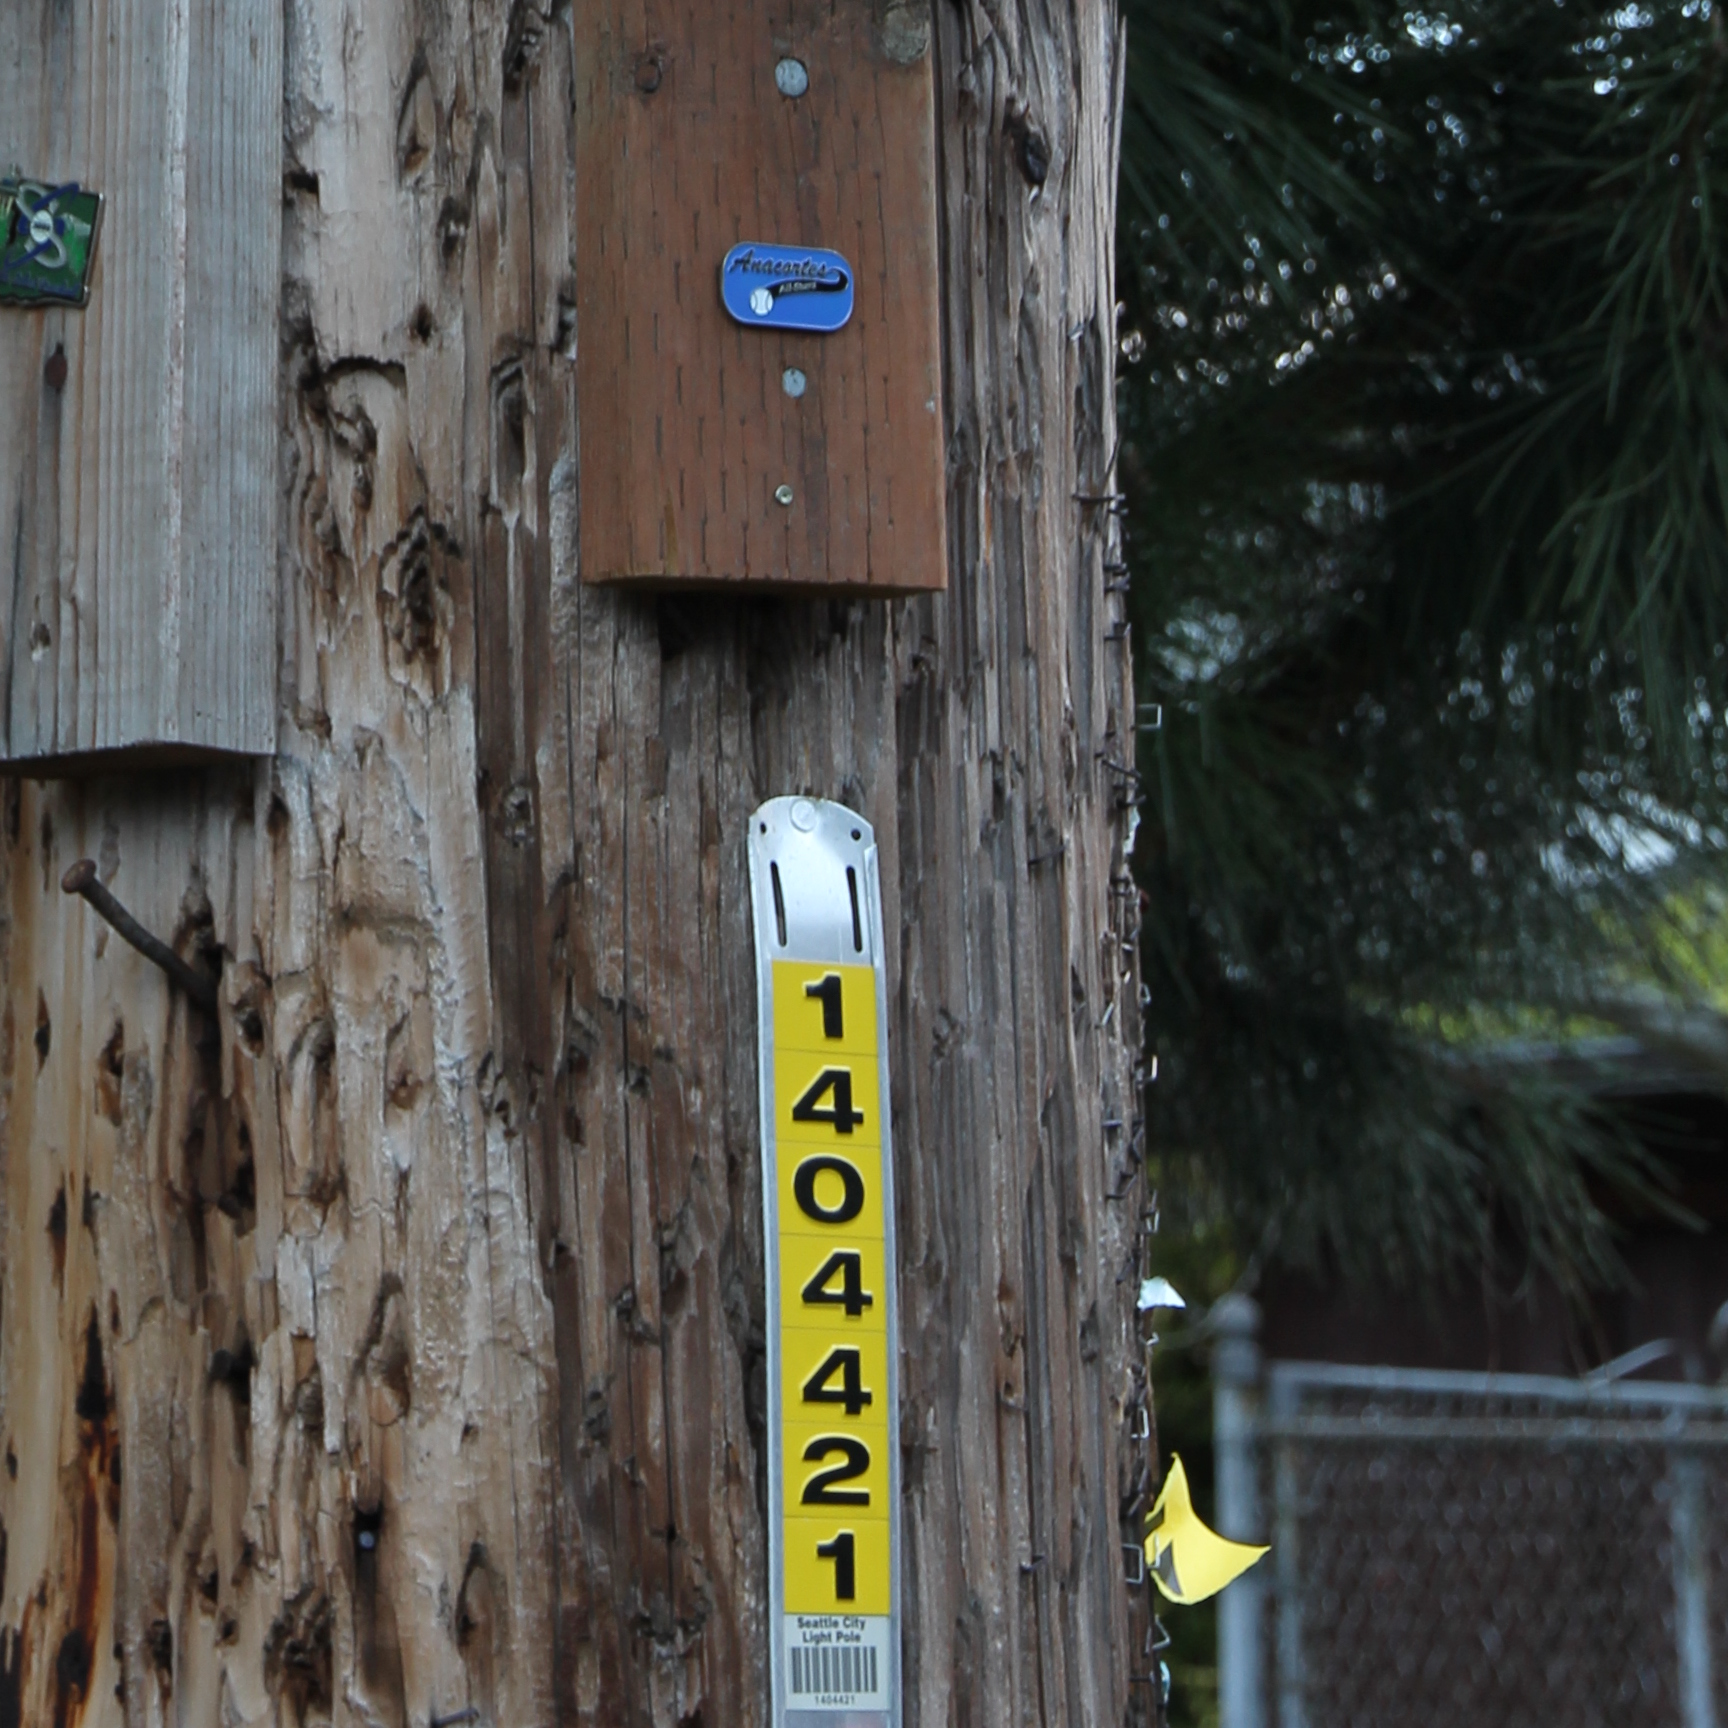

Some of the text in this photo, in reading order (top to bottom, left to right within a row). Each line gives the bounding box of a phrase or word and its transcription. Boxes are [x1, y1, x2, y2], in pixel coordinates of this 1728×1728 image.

[727, 247, 830, 278] Anacortes
[790, 971, 874, 1602] 1404421
[797, 1616, 866, 1631] Seattle City
[802, 1631, 861, 1645] Light Pole
